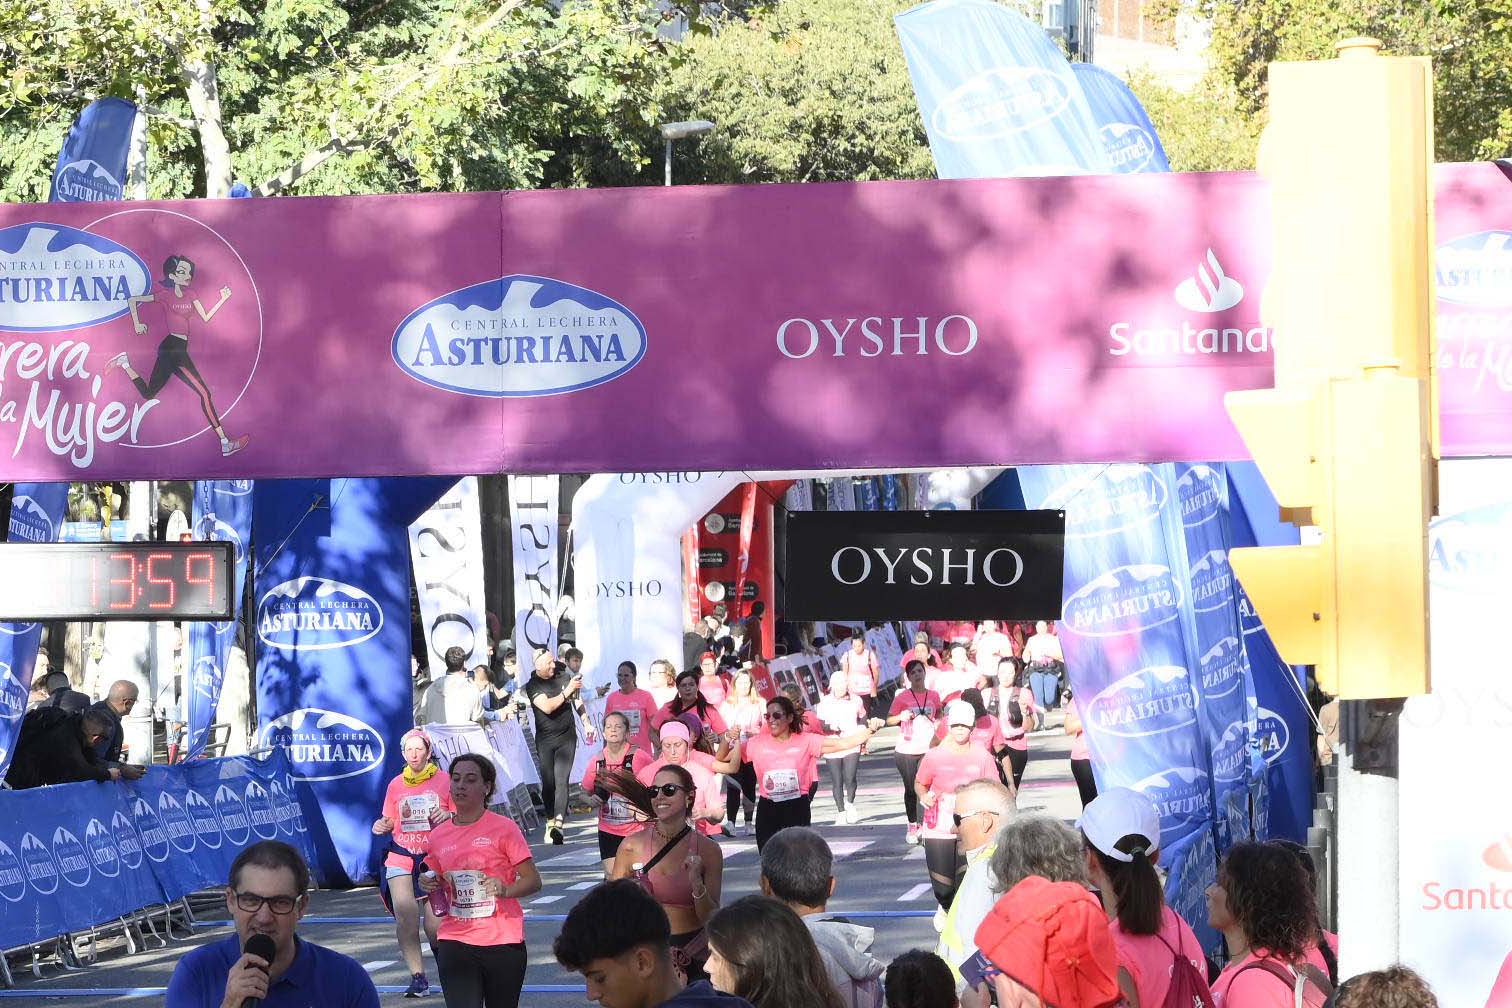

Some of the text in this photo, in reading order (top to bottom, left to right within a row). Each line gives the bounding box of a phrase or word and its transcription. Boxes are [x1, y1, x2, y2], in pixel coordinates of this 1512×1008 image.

[54, 258, 125, 271] LECHERA
[450, 315, 618, 331] CENTRAL LECHERA
[412, 322, 627, 367] ASTURIANA
[776, 315, 978, 359] OYSHO
[12, 375, 160, 468] Mujer
[831, 546, 1024, 587] OYSHO
[92, 554, 215, 609] 13:59
[274, 601, 369, 610] CENTRAL LECHERA
[261, 605, 374, 634] ASTURIANA
[321, 732, 370, 741] LECHERA
[288, 743, 375, 763] TURIANA
[457, 888, 474, 896] 016
